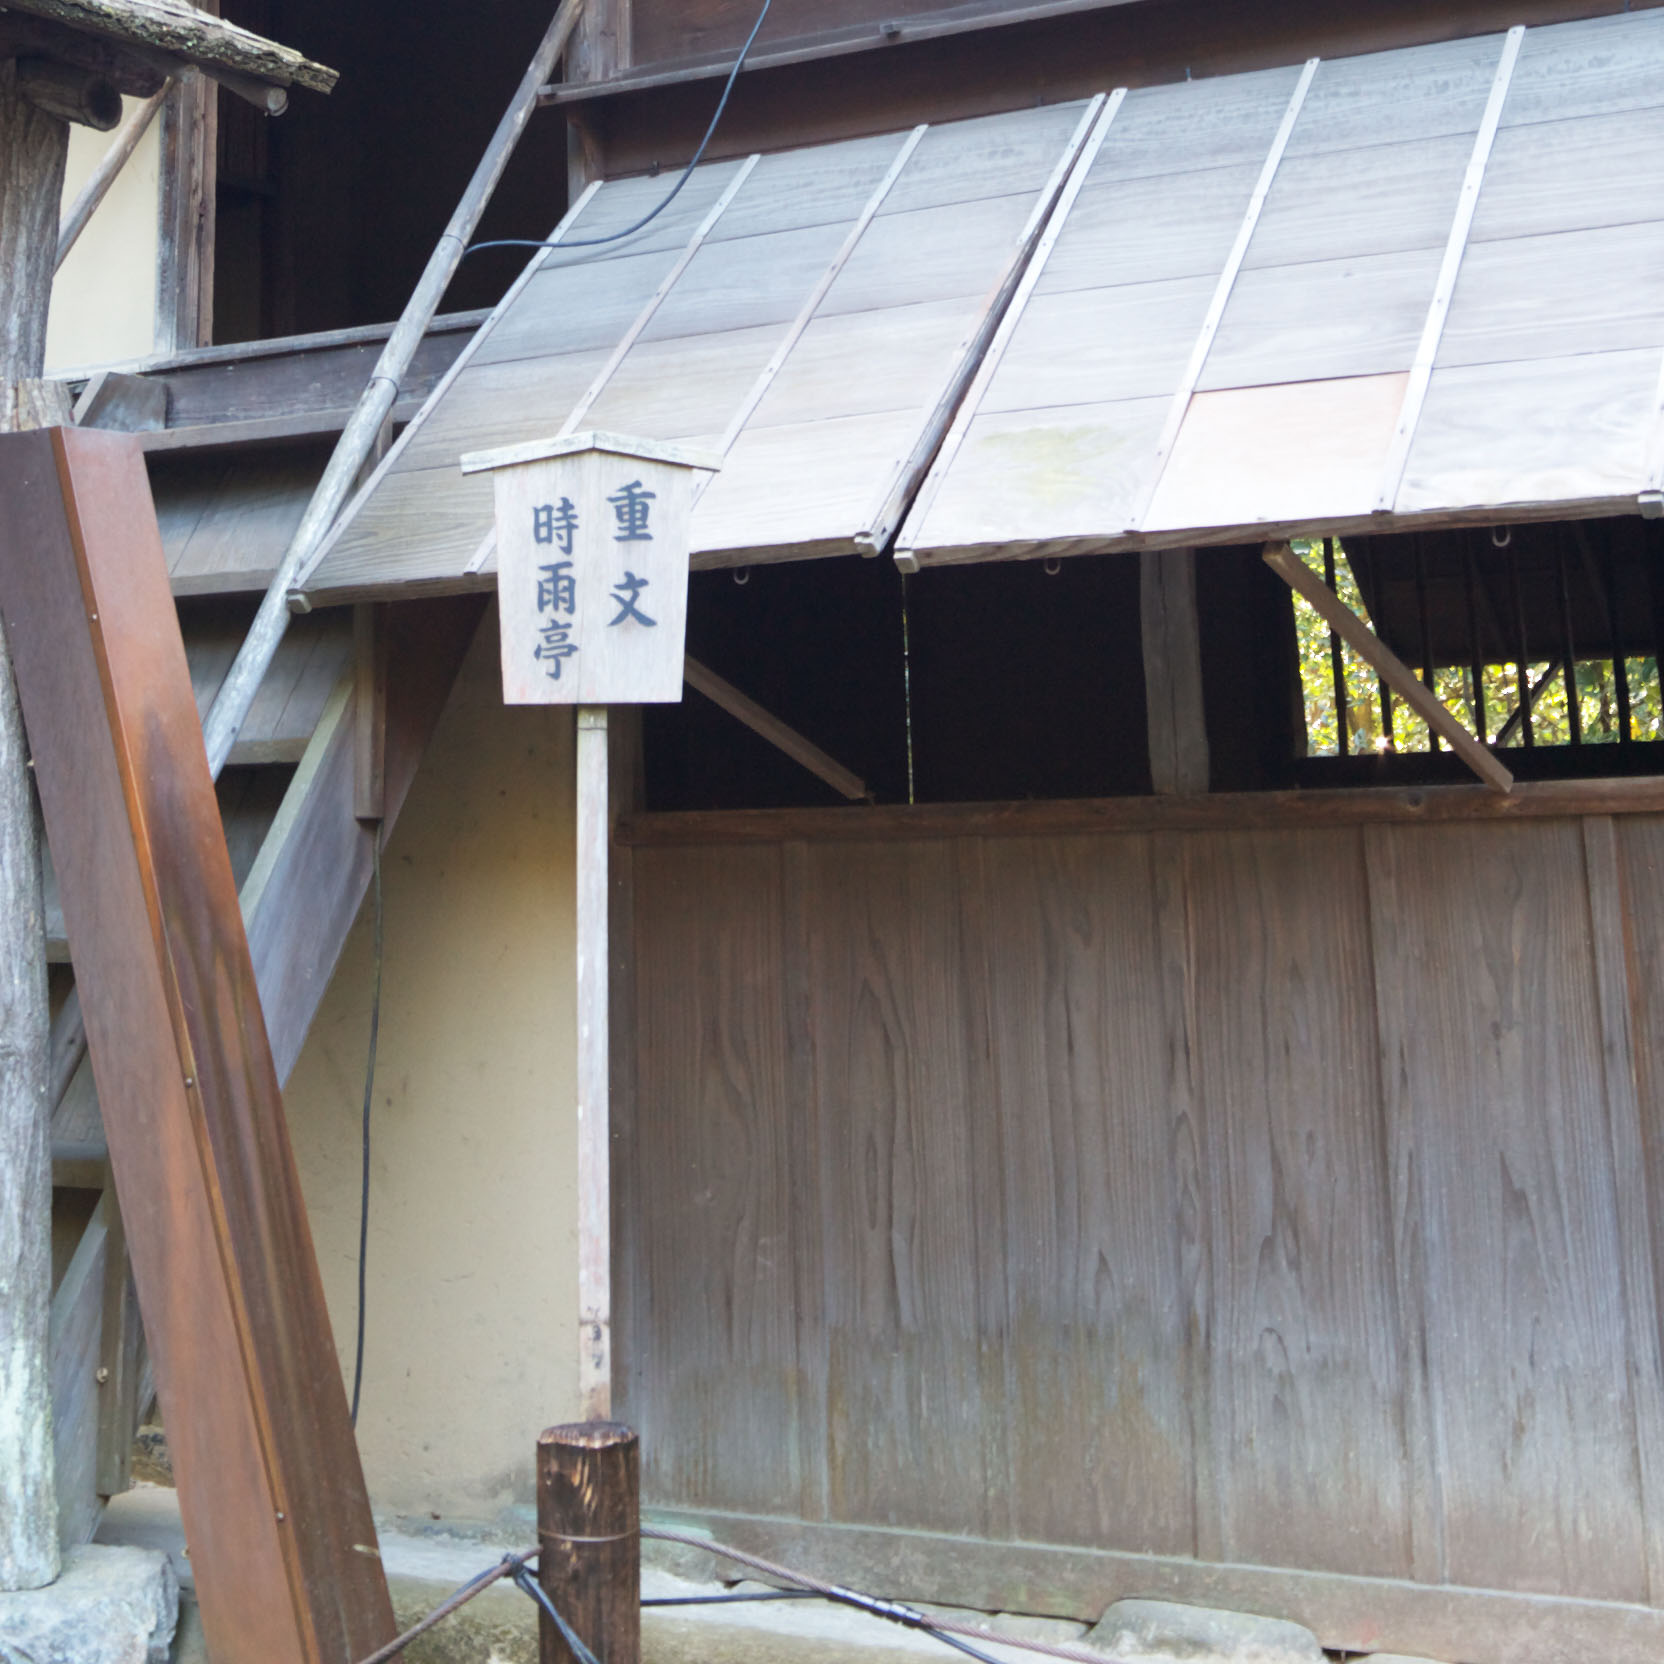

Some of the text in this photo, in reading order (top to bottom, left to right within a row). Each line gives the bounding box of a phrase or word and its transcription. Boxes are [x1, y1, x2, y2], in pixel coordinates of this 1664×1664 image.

[532, 496, 580, 681] 時雨亭
[606, 479, 658, 627] 重文
